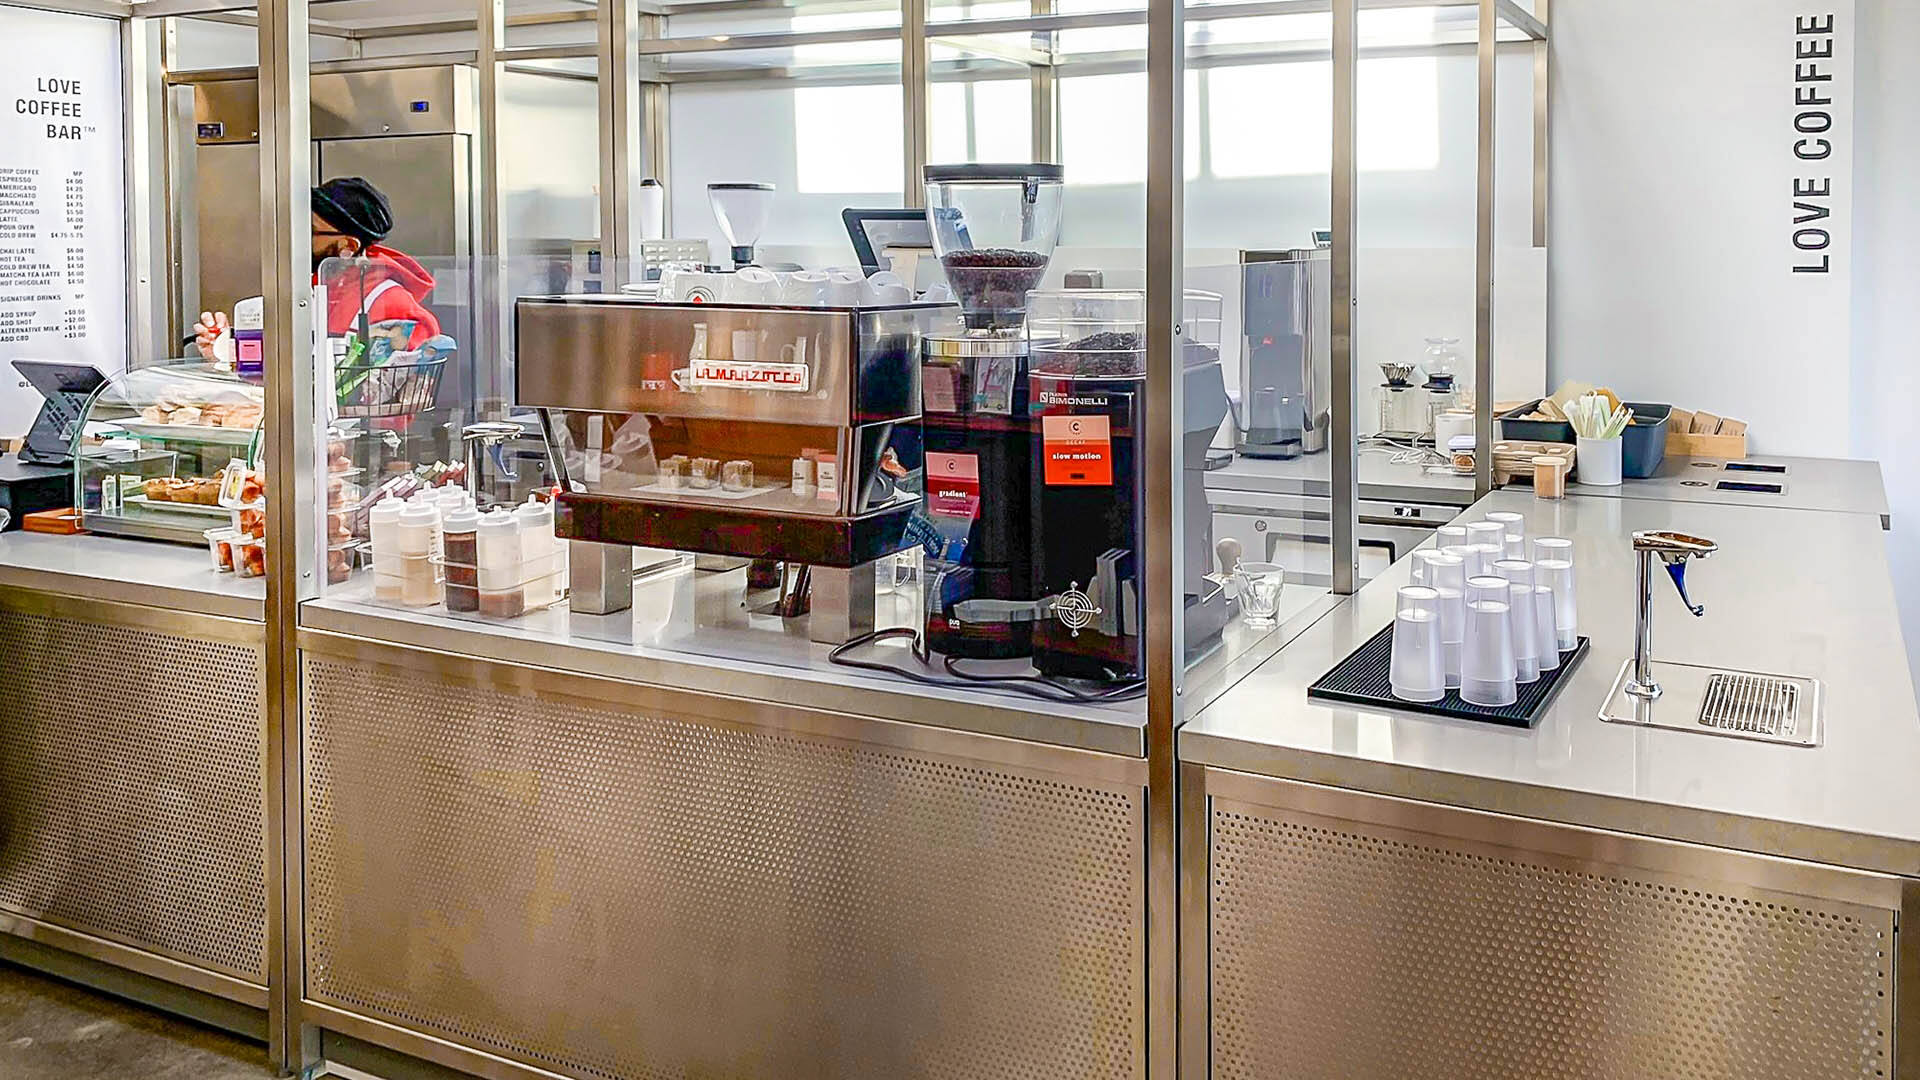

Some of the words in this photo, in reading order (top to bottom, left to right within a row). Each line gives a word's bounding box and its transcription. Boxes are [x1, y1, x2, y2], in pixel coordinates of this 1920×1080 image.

[37, 77, 81, 95] LOVE
[1793, 14, 1834, 160] COFFEE
[16, 98, 81, 118] COFFEE
[1793, 178, 1830, 273] LOVE
[1052, 452, 1071, 460] slow
[1072, 452, 1102, 460] motion
